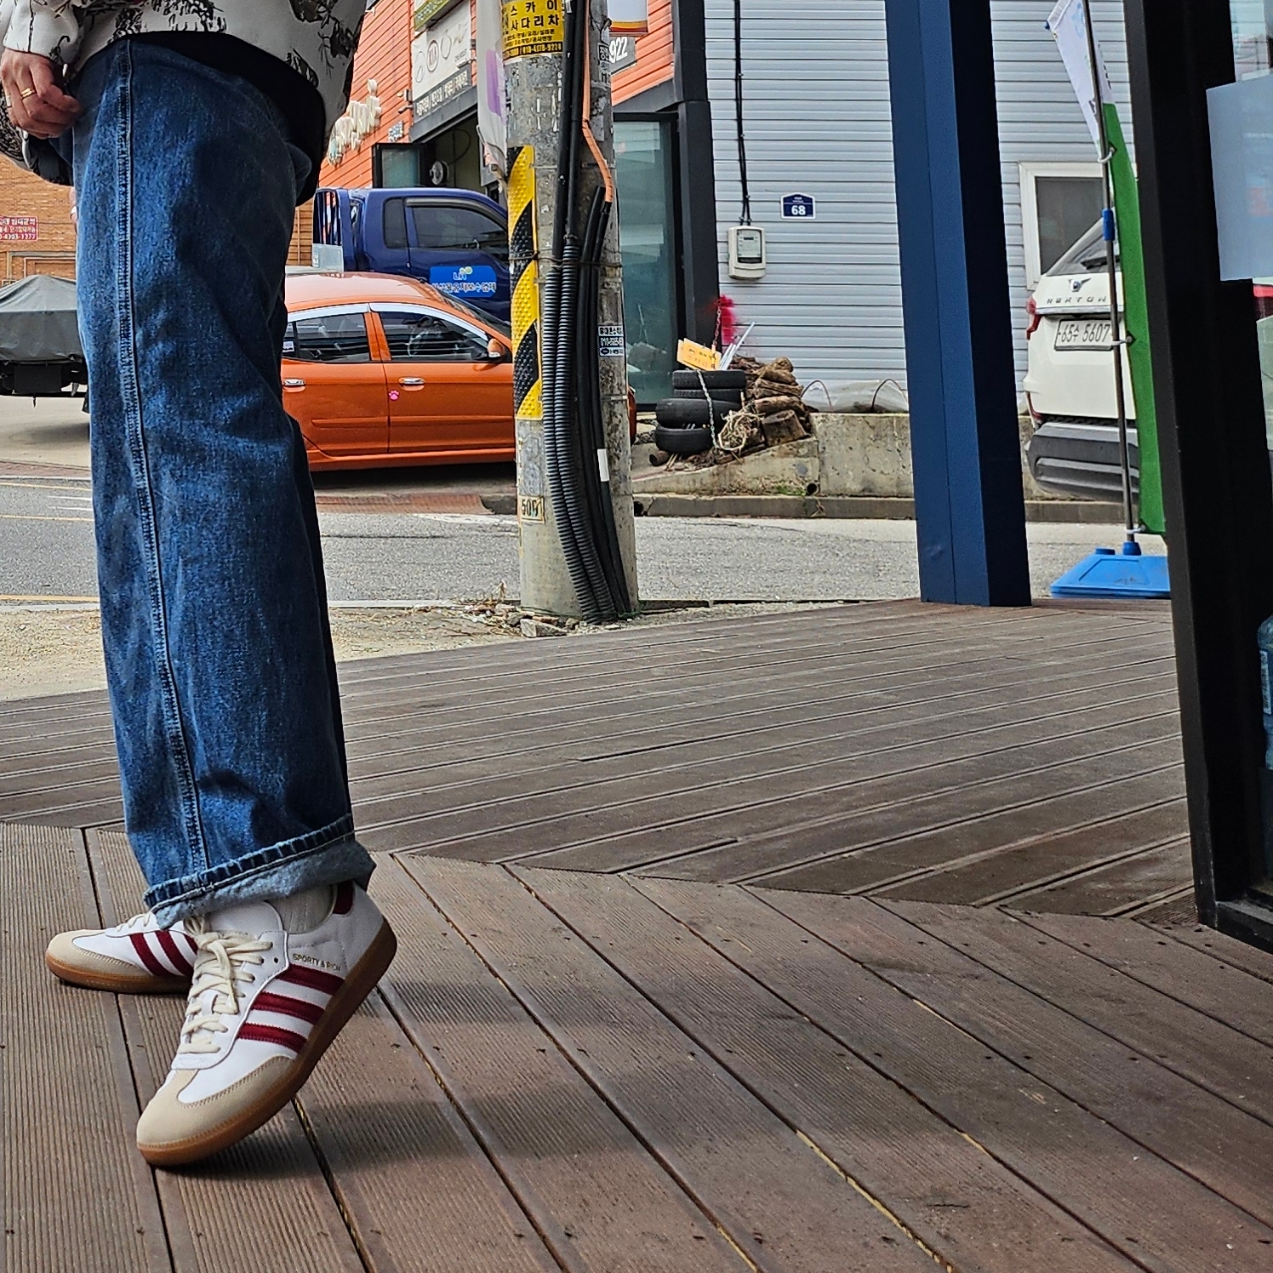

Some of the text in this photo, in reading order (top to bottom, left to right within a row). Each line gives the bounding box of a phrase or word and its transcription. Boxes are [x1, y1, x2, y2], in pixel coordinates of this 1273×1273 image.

[511, 13, 560, 31] 사다리차
[608, 37, 628, 64] 922
[791, 205, 806, 215] 68
[1046, 296, 1107, 304] REXTON
[1082, 323, 1111, 342] 5607
[292, 953, 320, 966] SPORTY
[326, 961, 342, 972] RICH
